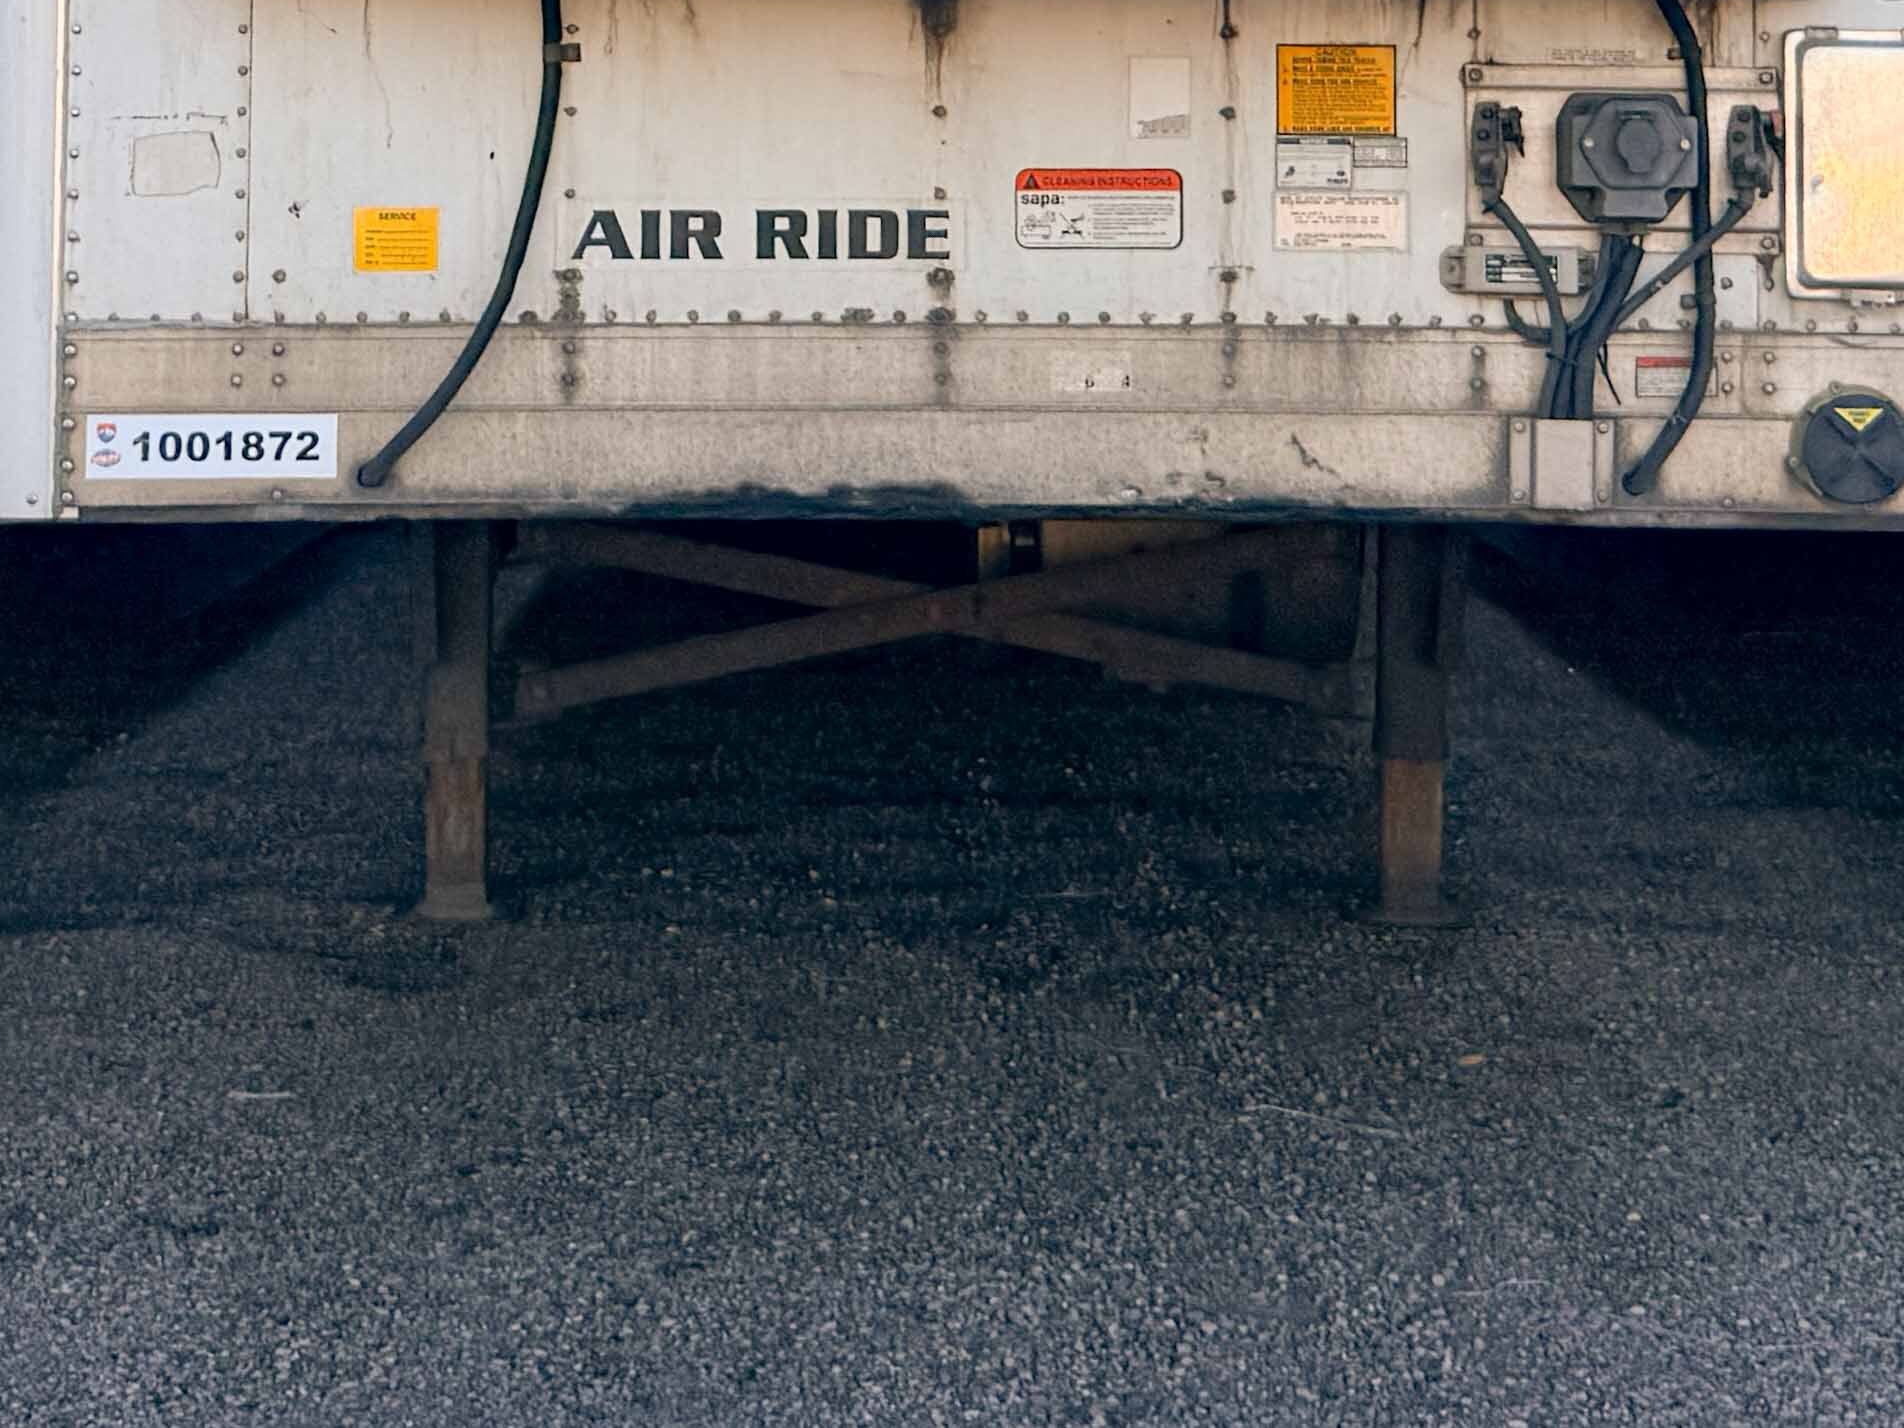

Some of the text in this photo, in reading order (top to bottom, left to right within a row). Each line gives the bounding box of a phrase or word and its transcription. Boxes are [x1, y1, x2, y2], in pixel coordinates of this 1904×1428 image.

[572, 209, 950, 259] AIR RIDE
[132, 431, 320, 462] 1001872
